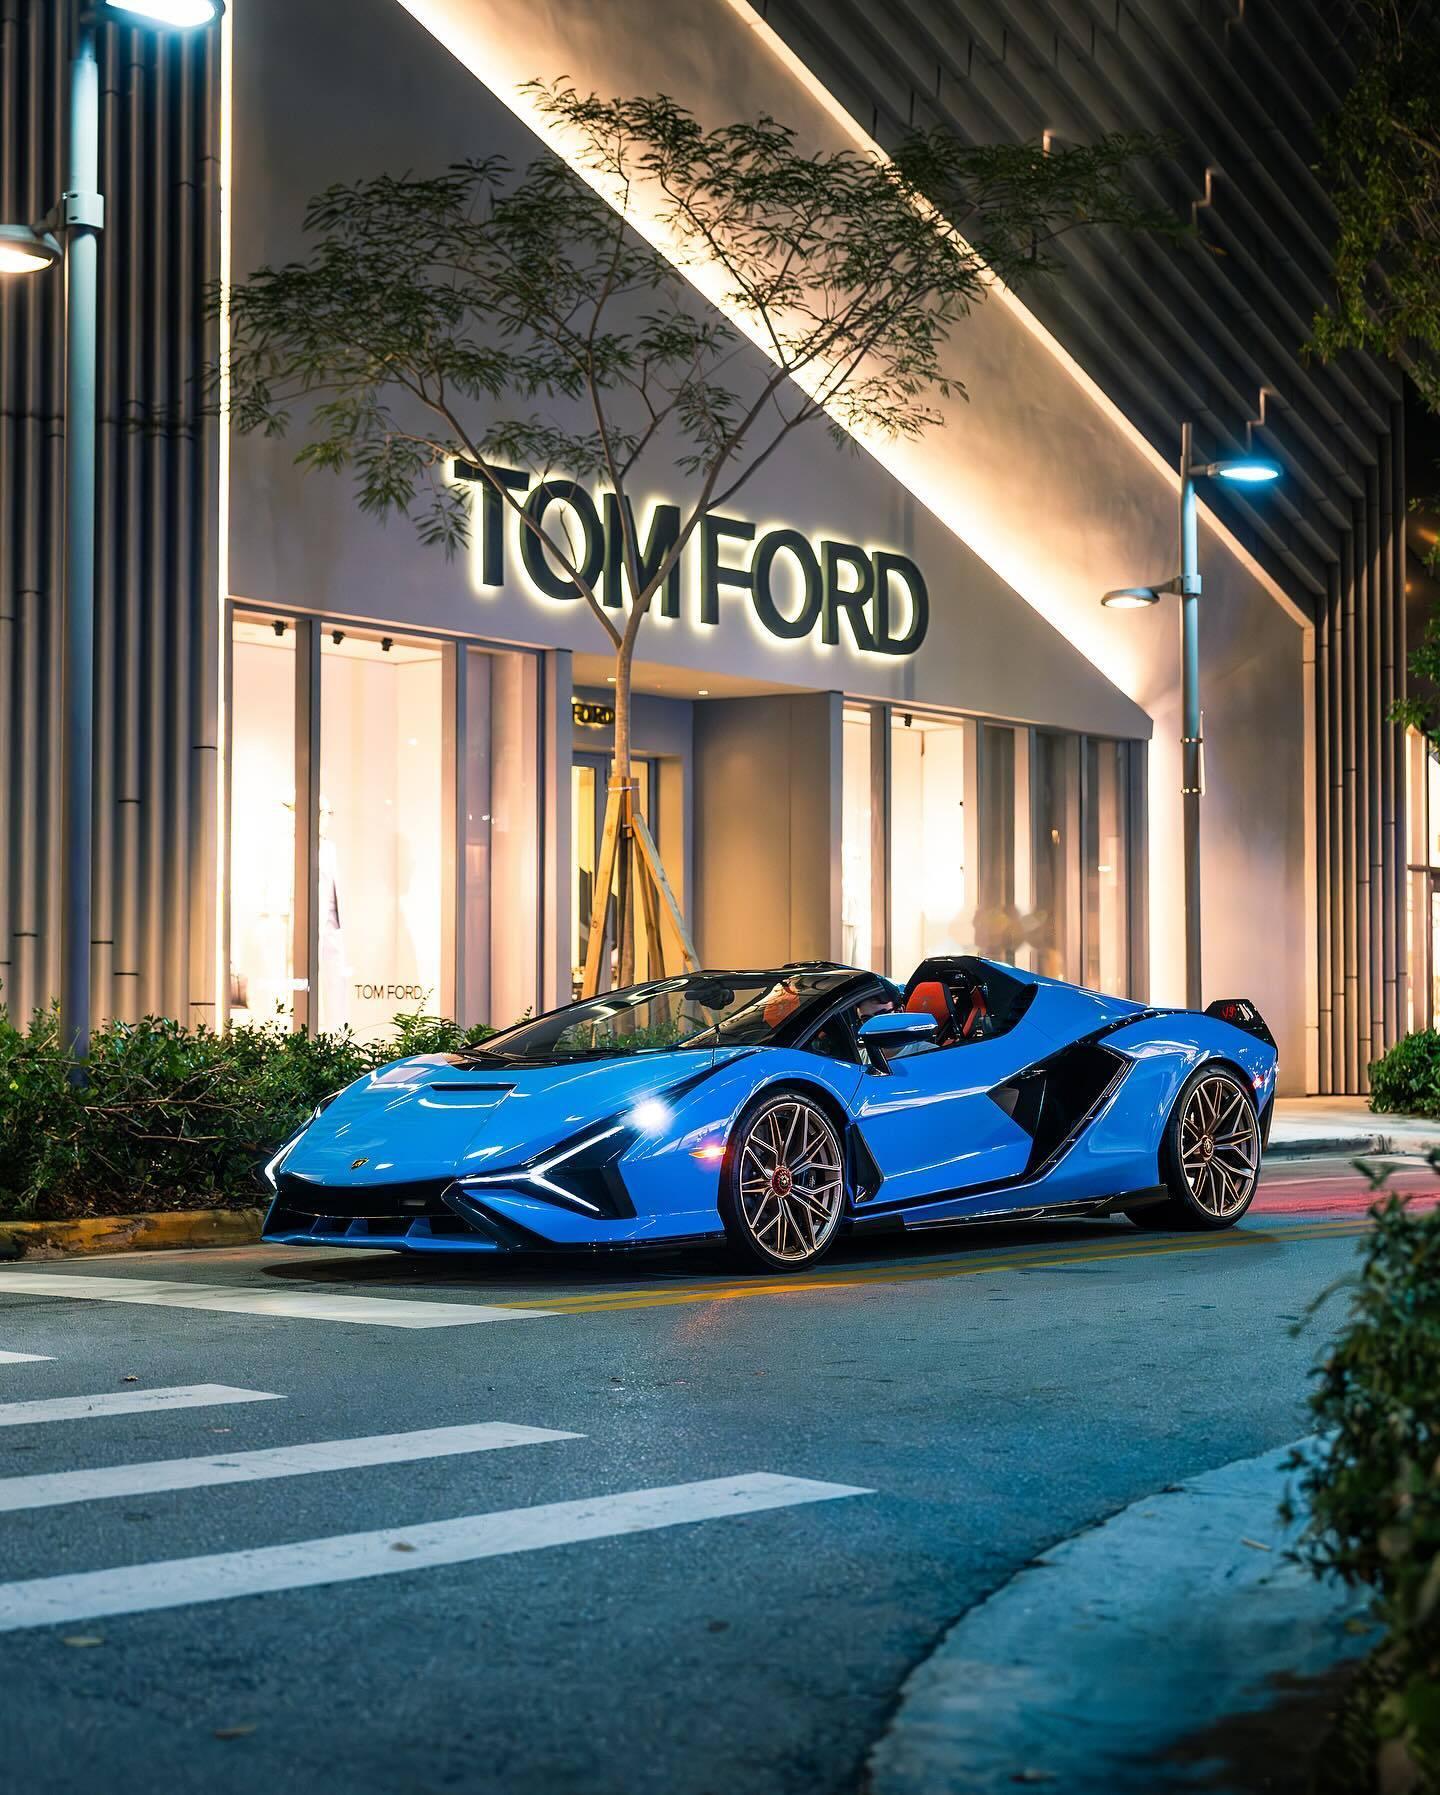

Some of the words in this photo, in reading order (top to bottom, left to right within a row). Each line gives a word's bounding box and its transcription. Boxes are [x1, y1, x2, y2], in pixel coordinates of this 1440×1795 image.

[453, 459, 681, 619] TOM
[700, 513, 930, 656] FORD
[573, 703, 616, 725] FORD
[354, 984, 384, 1000] TOM
[387, 985, 423, 1000] FORD
